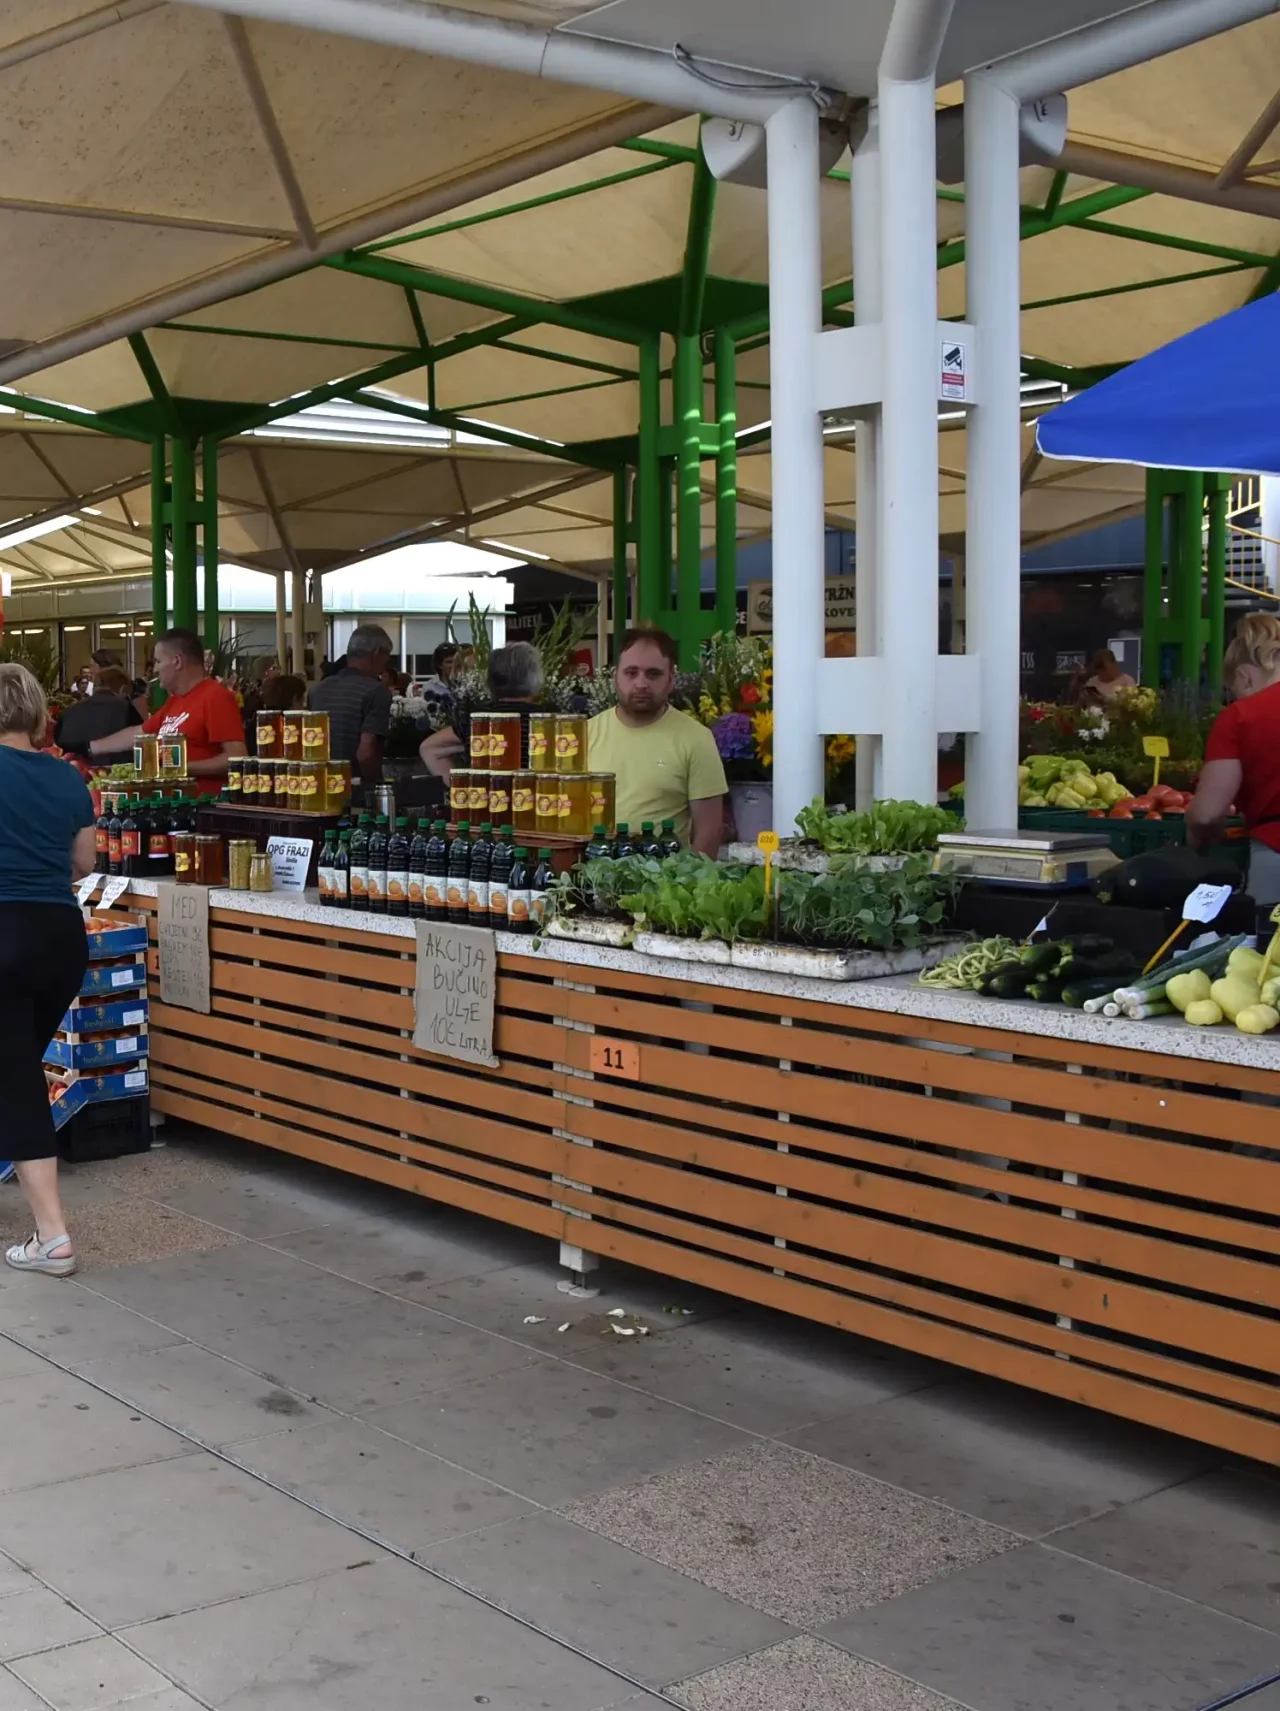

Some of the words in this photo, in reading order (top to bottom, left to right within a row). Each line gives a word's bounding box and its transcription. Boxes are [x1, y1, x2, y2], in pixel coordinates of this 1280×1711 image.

[824, 584, 856, 601] TRŽN
[267, 844, 286, 856] OPG
[286, 845, 310, 858] FRAZI
[171, 893, 198, 920] MED
[425, 933, 487, 973] AKCIJA
[433, 964, 488, 999] BUČINO
[603, 1047, 625, 1070] 11
